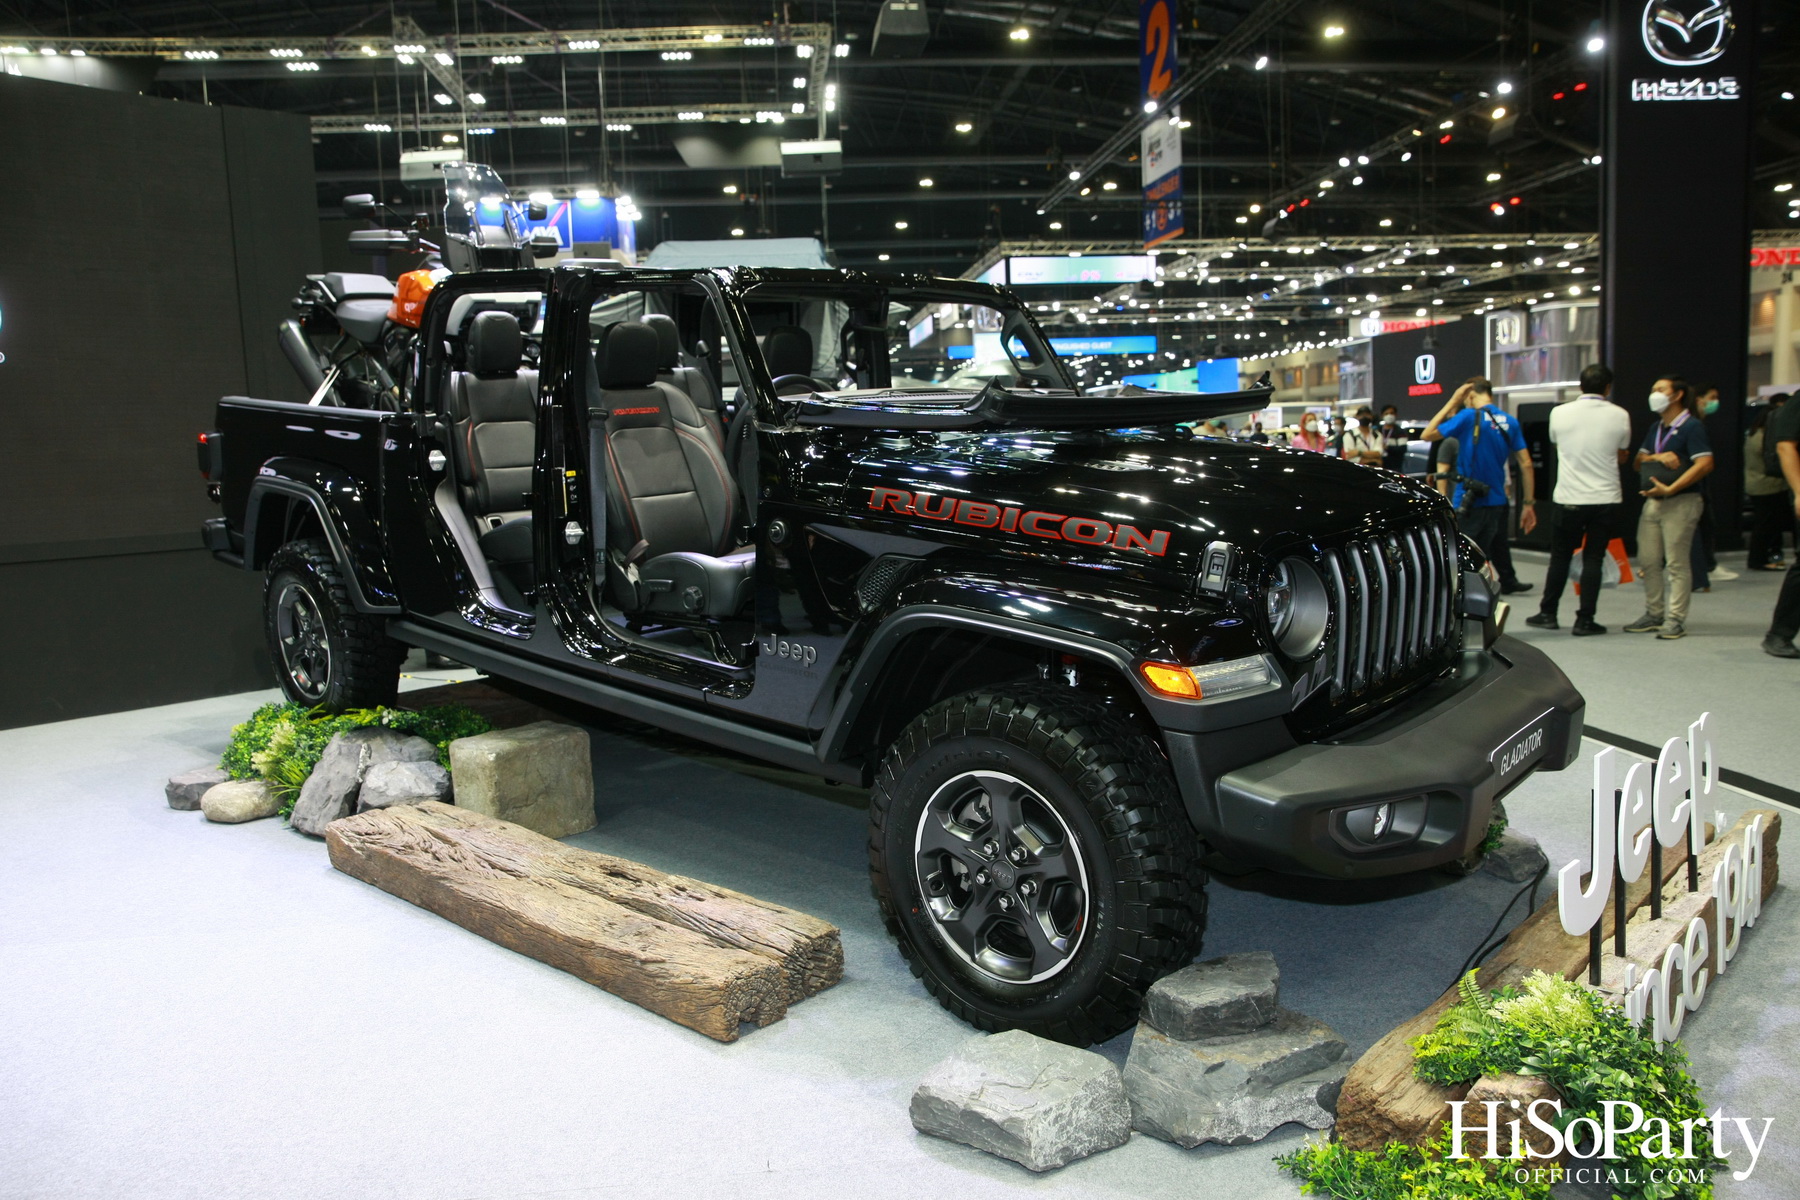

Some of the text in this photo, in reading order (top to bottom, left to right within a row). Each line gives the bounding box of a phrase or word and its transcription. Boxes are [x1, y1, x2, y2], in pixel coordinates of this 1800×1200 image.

[1145, 1, 1172, 98] 2
[868, 486, 1171, 557] RUBICON
[763, 633, 817, 668] Jeep
[1500, 728, 1543, 776] GLADIATOR
[1558, 711, 1719, 937] Jeep
